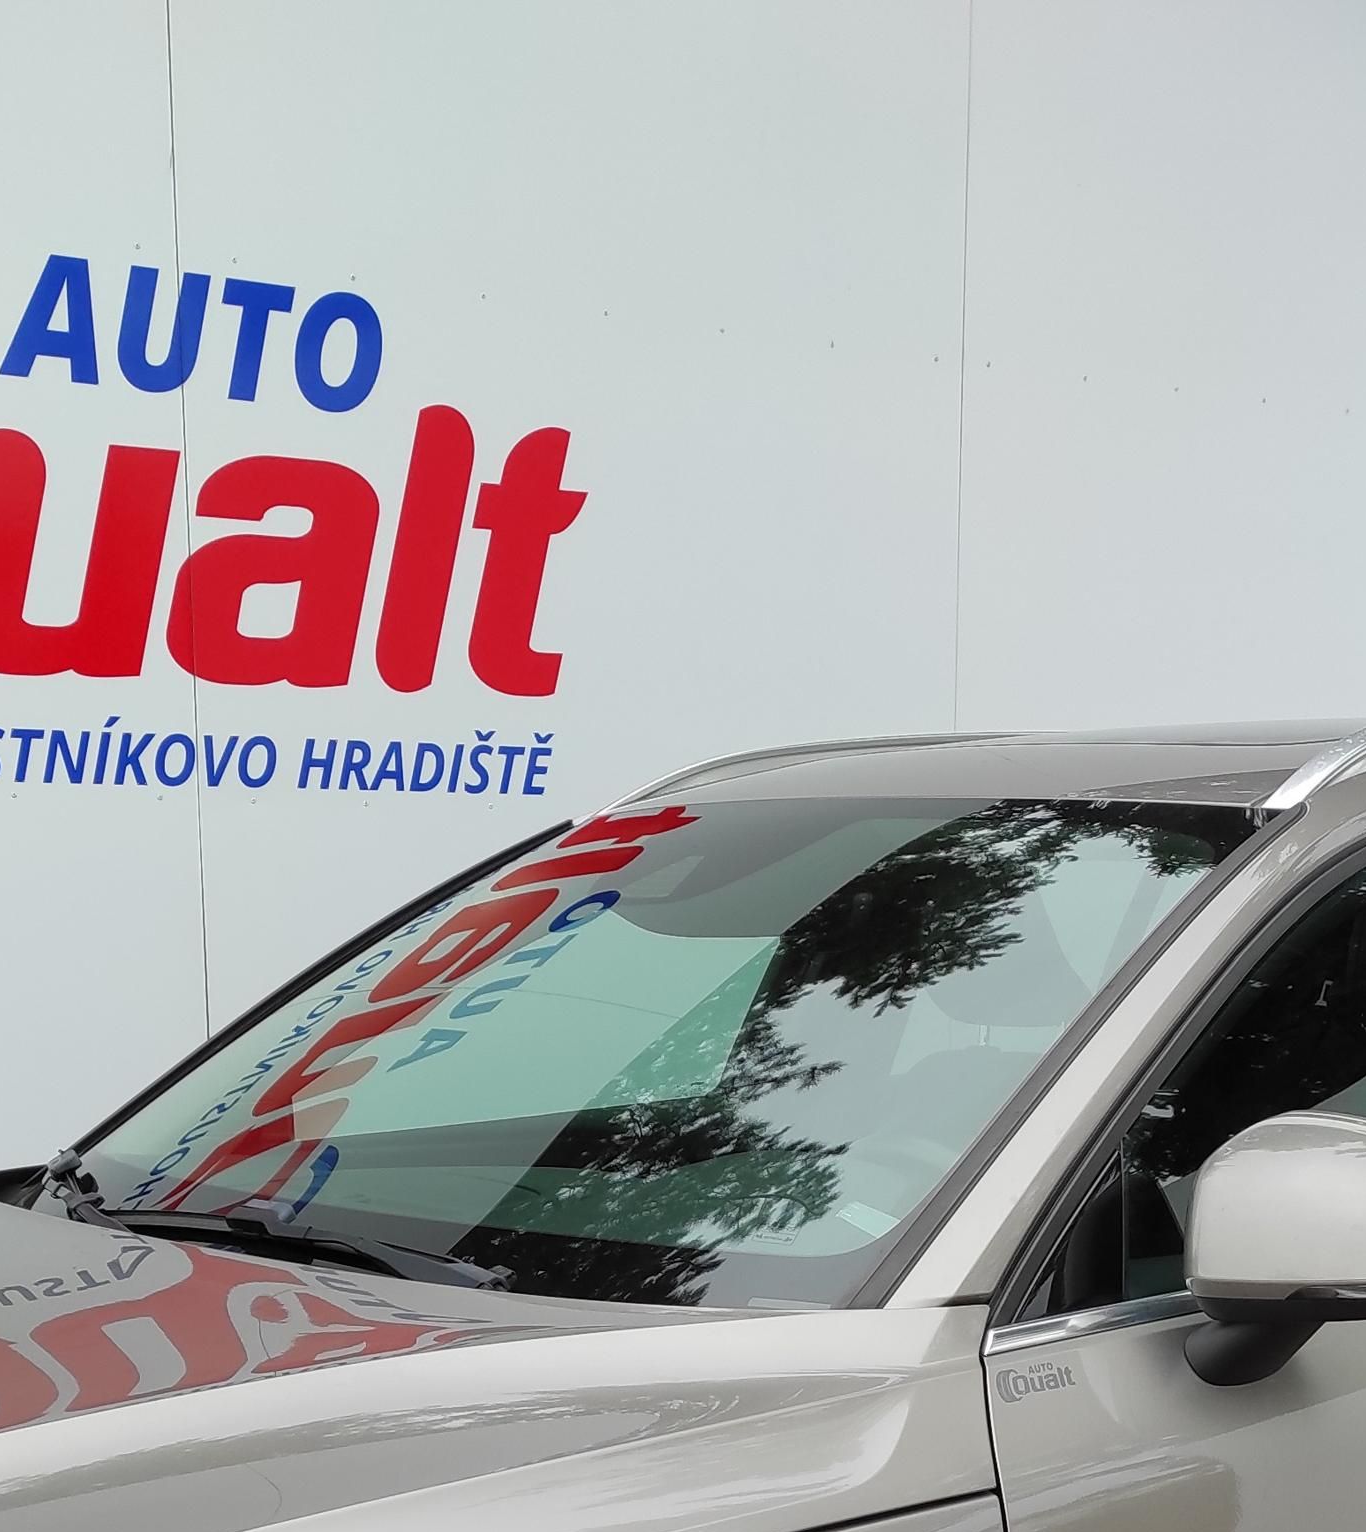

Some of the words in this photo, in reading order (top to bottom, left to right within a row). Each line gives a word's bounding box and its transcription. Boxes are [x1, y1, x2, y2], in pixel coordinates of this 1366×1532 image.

[296, 729, 553, 796] HRADIŠTĚ
[1011, 1366, 1076, 1396] Qualt
[1028, 1362, 1053, 1375] AUTO
